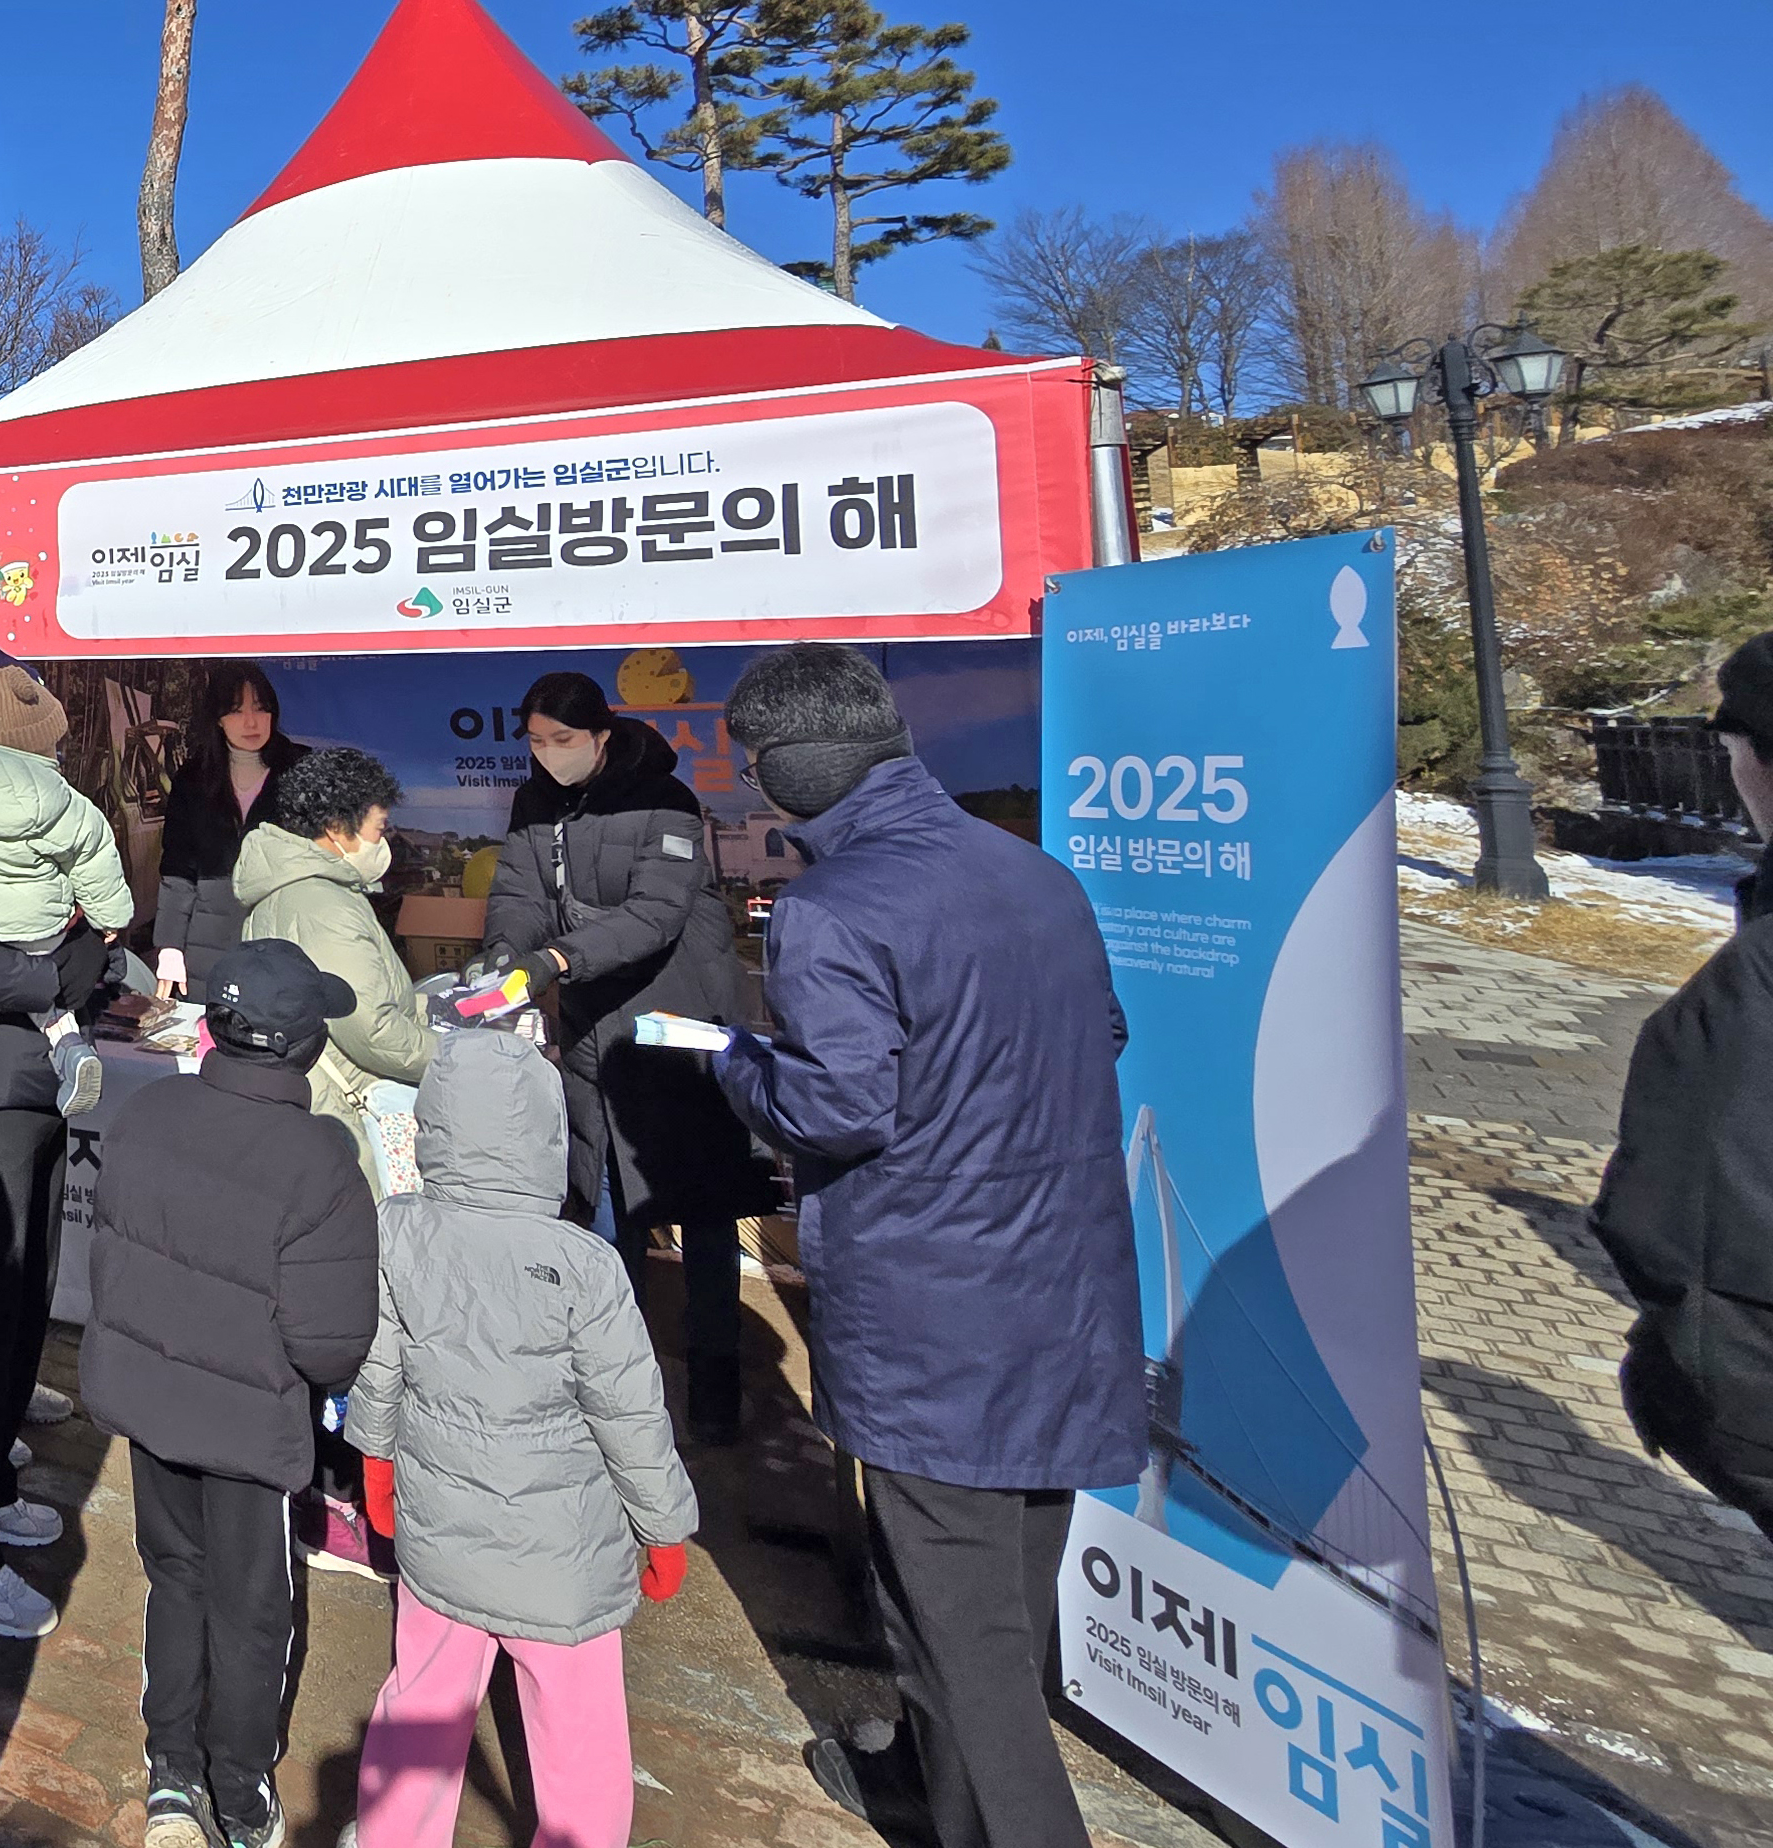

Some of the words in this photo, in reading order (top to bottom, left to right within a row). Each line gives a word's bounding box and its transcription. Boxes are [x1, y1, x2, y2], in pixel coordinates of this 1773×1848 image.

[282, 480, 368, 506] 천만관광
[374, 475, 442, 499] 시대를
[449, 467, 546, 494] 열어가는
[553, 451, 721, 486] 임실군입니다.
[226, 517, 392, 580] 2025
[413, 482, 802, 574] 임실방문의
[828, 474, 917, 550] 해
[92, 546, 146, 564] 이제
[150, 550, 200, 583] 임실
[452, 585, 510, 595] IMSIL-GUN
[452, 596, 513, 615] 임실군
[1066, 627, 1108, 643] 이제,
[1111, 621, 1163, 651] 임실을
[1167, 612, 1252, 635] 바라보다
[455, 756, 497, 770] 2025
[500, 756, 527, 770] 임실
[456, 774, 491, 788] Visit
[1068, 755, 1249, 823] 2025
[1068, 835, 1122, 871] 임실
[1128, 839, 1212, 878] 방문의
[1218, 842, 1252, 880] 해
[1124, 906, 1158, 920] place
[1160, 910, 1202, 926] where
[1204, 914, 1252, 931] charm
[1137, 925, 1161, 938] and
[1163, 927, 1209, 944] culture
[1212, 935, 1236, 947] are
[1151, 941, 1171, 955] the
[1173, 945, 1240, 967] backdrop
[1166, 960, 1215, 978] natural
[1081, 1546, 1239, 1680] 이제
[1085, 1616, 1132, 1658] 2025
[1137, 1646, 1168, 1683] 임실
[1170, 1665, 1220, 1715] 방문의
[1222, 1698, 1241, 1728] 해
[1086, 1642, 1124, 1682] Visit
[1127, 1668, 1167, 1709] Imsil
[1170, 1699, 1213, 1735] year
